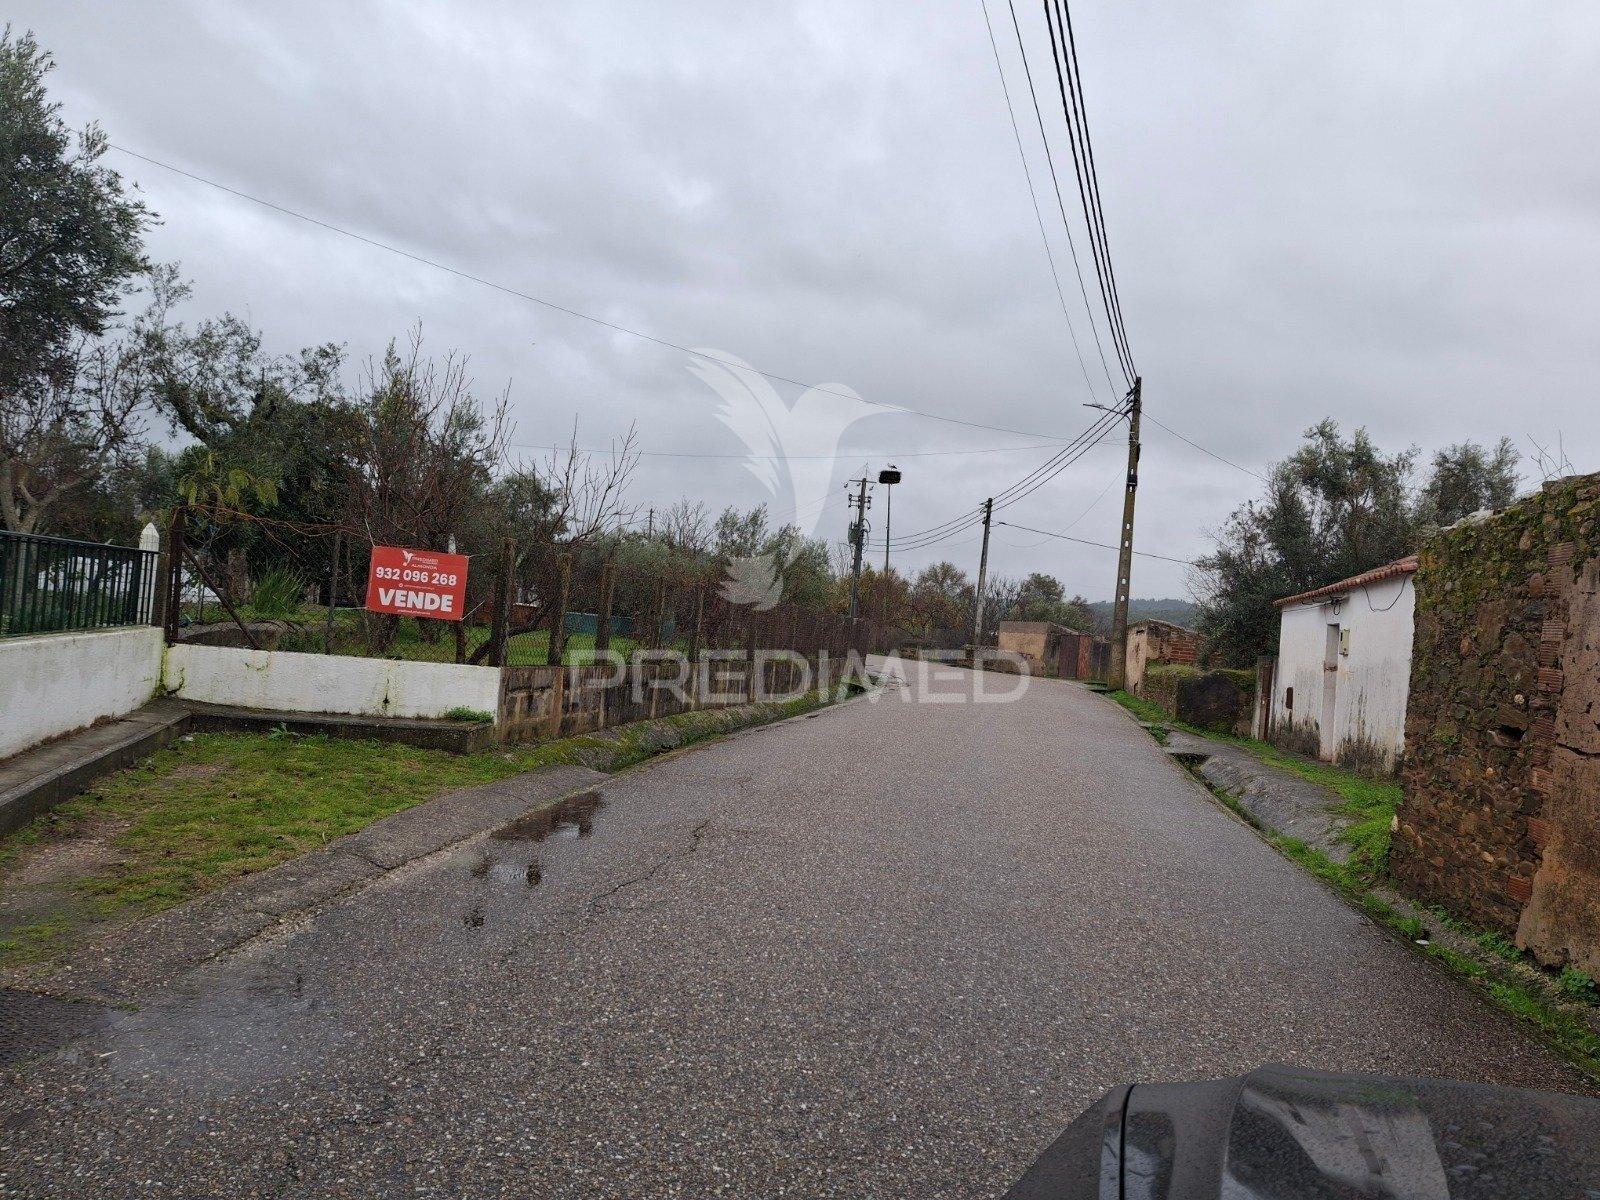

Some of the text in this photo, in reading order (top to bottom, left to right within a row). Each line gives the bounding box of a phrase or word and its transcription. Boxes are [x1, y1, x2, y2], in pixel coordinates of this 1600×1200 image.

[376, 566, 457, 586] 932 096 268
[378, 587, 454, 612] VENDE
